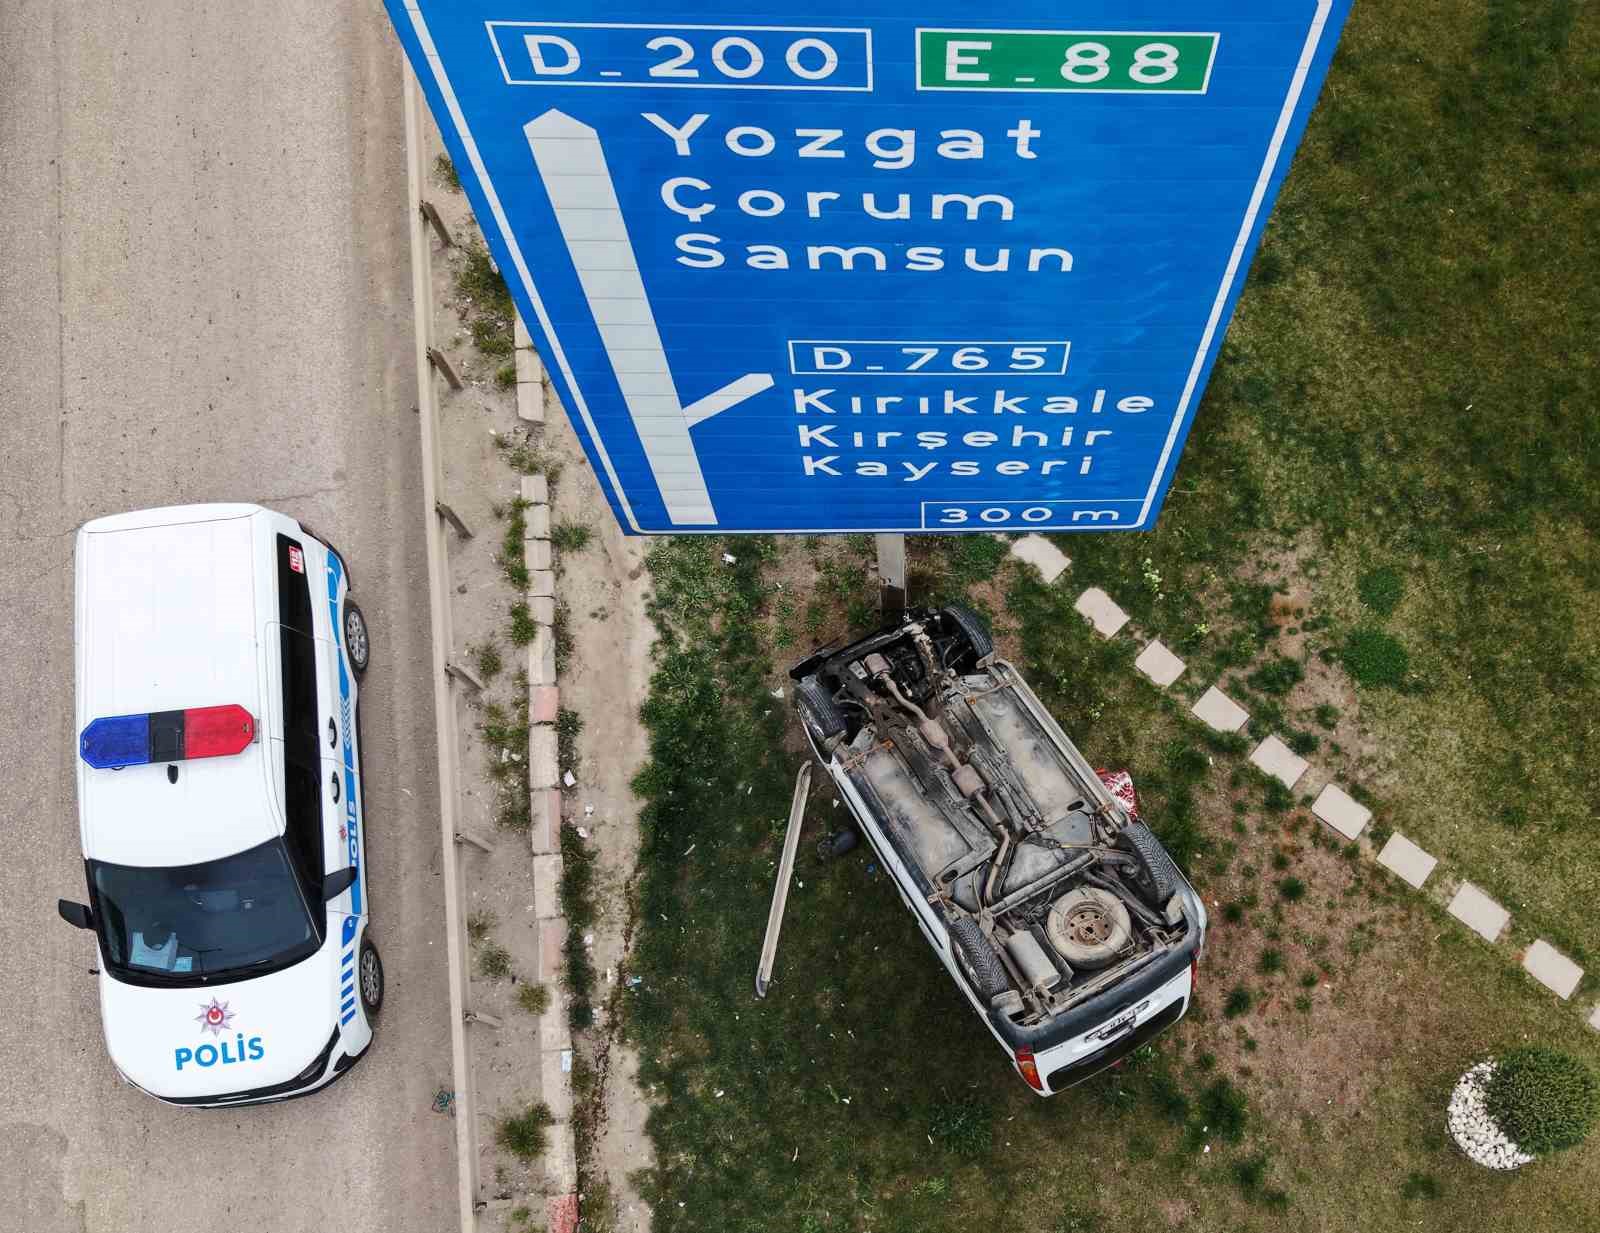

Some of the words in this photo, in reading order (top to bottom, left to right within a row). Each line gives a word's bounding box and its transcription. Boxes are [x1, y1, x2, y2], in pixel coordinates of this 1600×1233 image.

[641, 112, 1041, 170] Yozgat
[660, 176, 1014, 223] Çorum
[675, 233, 1073, 272] Samsun
[793, 388, 1155, 415] Kırıkkale
[798, 424, 1113, 450] Kırşehir
[802, 455, 1093, 482] Kayseri
[939, 507, 1053, 523] 300
[1072, 510, 1120, 521] m
[174, 1033, 265, 1071] POLİS
